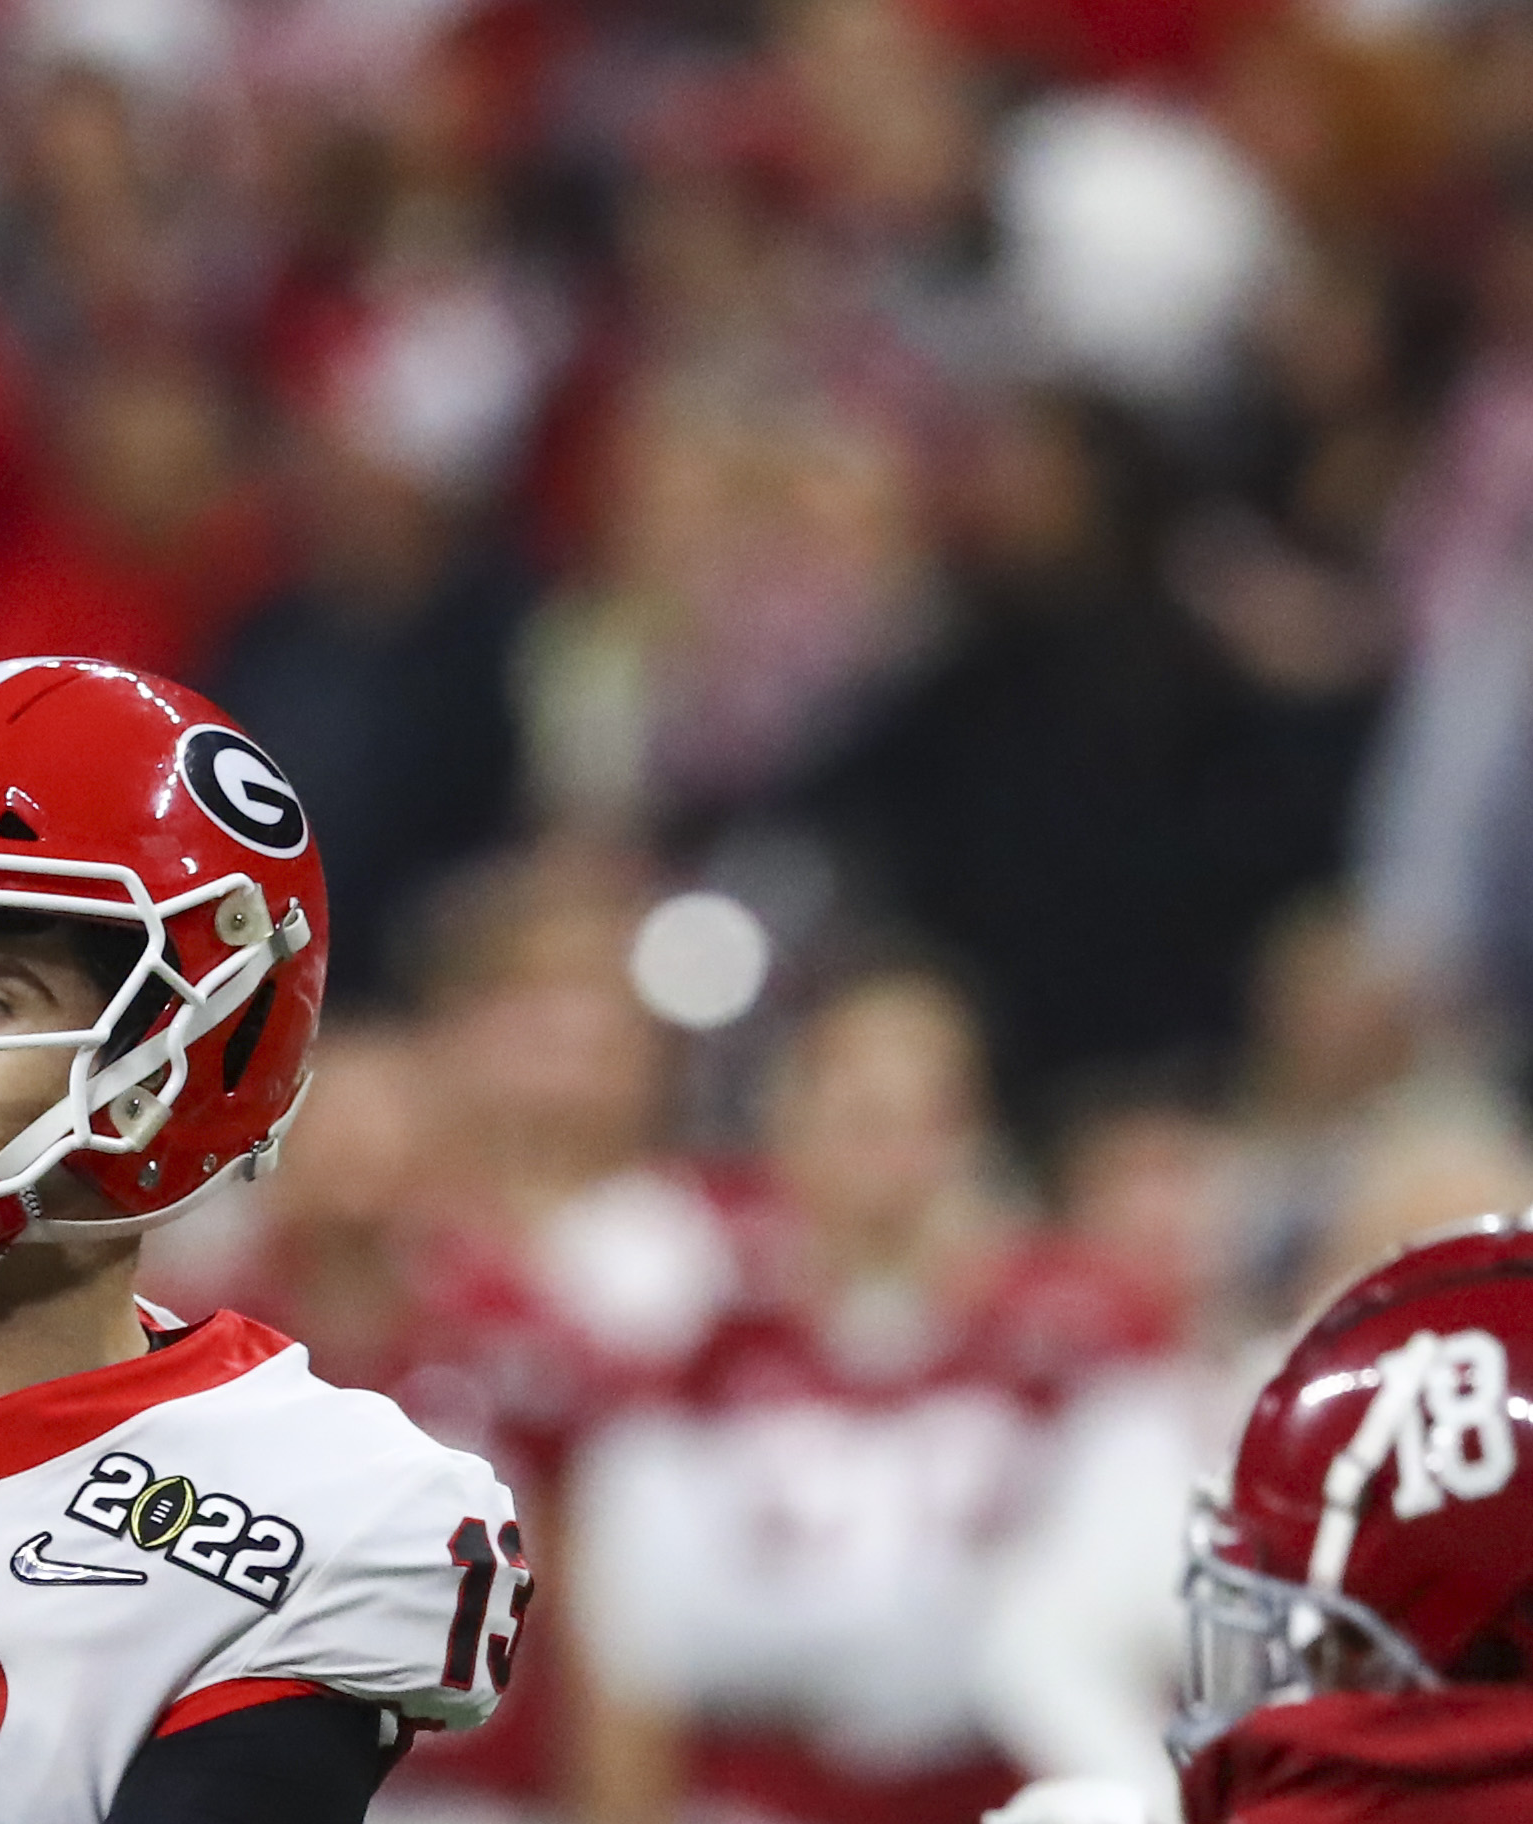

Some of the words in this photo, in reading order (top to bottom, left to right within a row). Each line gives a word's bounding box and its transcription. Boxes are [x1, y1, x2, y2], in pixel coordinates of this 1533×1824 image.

[177, 723, 308, 859] G
[64, 1451, 305, 1613] 2022
[446, 1515, 534, 1695] 13
